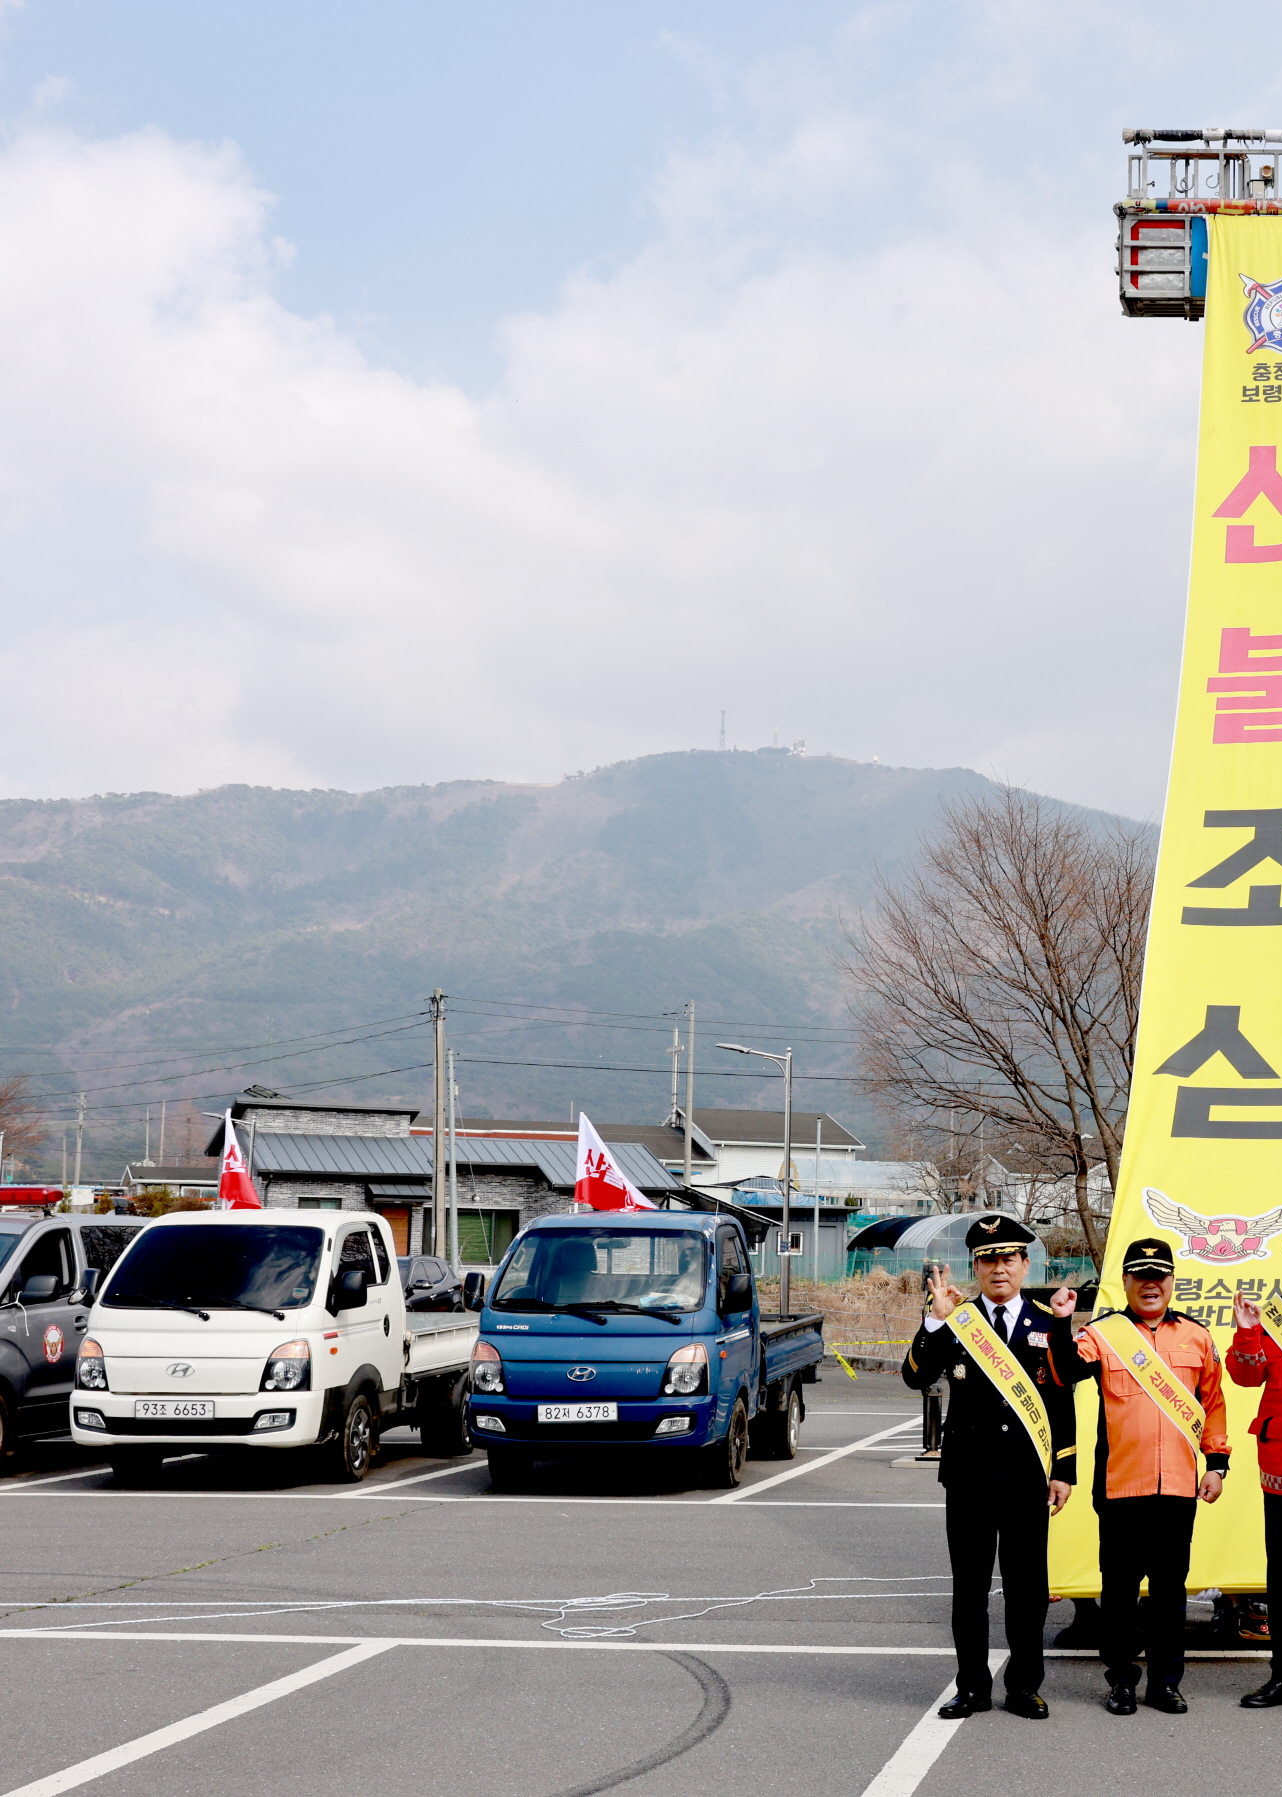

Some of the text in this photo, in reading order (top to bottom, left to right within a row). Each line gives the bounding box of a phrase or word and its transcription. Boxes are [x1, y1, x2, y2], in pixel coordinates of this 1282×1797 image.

[970, 1327, 1050, 1456] 산불조심 예방이 먼저
[1149, 1371, 1195, 1422] 산불조심
[142, 1403, 206, 1416] 93조 6653
[545, 1405, 610, 1420] 82저 6378
